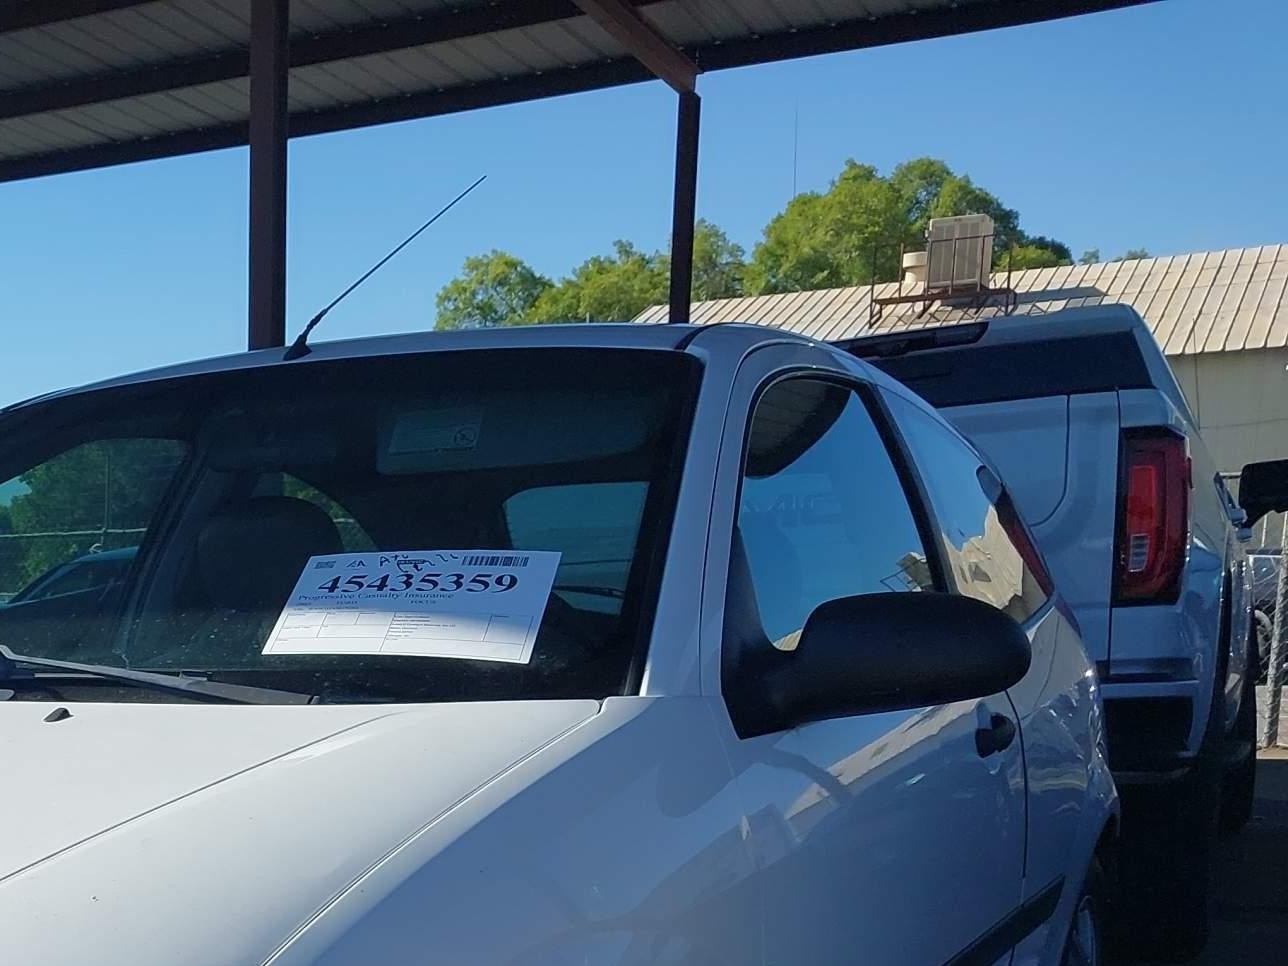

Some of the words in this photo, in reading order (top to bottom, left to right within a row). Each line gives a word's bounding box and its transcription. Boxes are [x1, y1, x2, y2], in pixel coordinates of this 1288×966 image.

[318, 574, 518, 594] 45435359
[298, 592, 355, 601] Progressive
[357, 591, 399, 600] Casualty
[403, 591, 454, 599] Insurance
